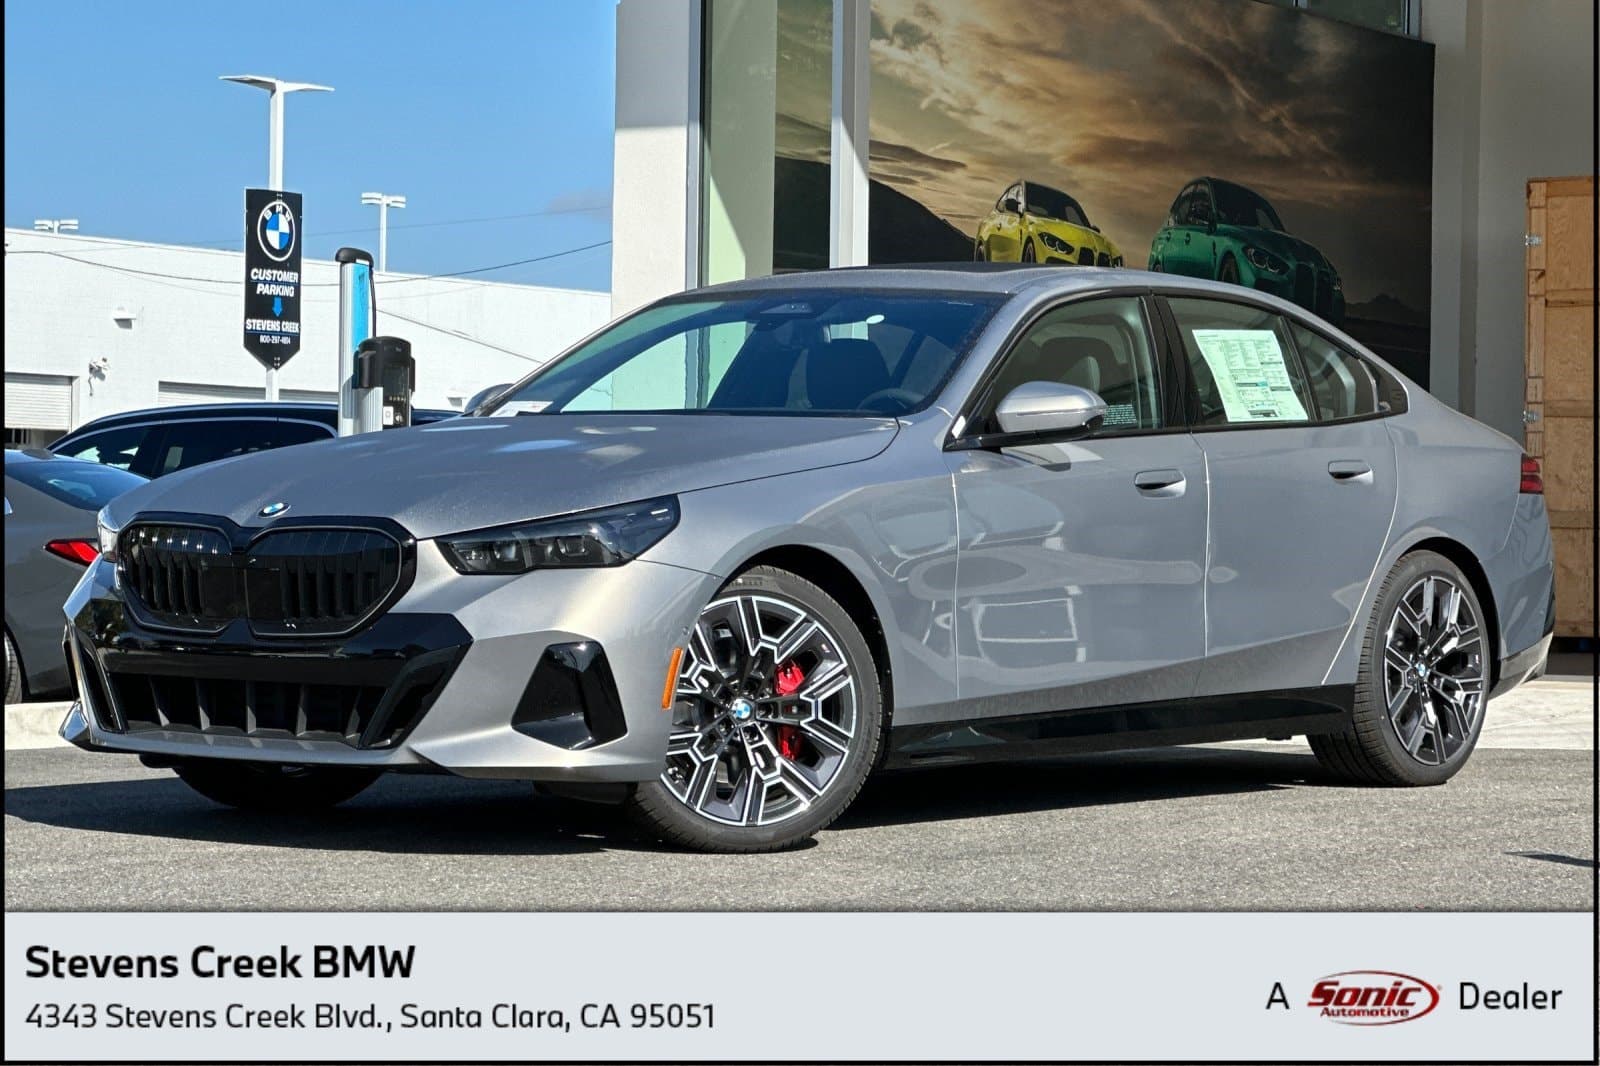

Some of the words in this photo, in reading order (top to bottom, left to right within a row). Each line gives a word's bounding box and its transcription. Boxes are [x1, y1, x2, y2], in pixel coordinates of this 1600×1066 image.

[250, 268, 299, 283] CUSTOMER
[256, 282, 295, 297] PARKING
[245, 319, 281, 332] STEVENS
[281, 321, 300, 334] CREEK
